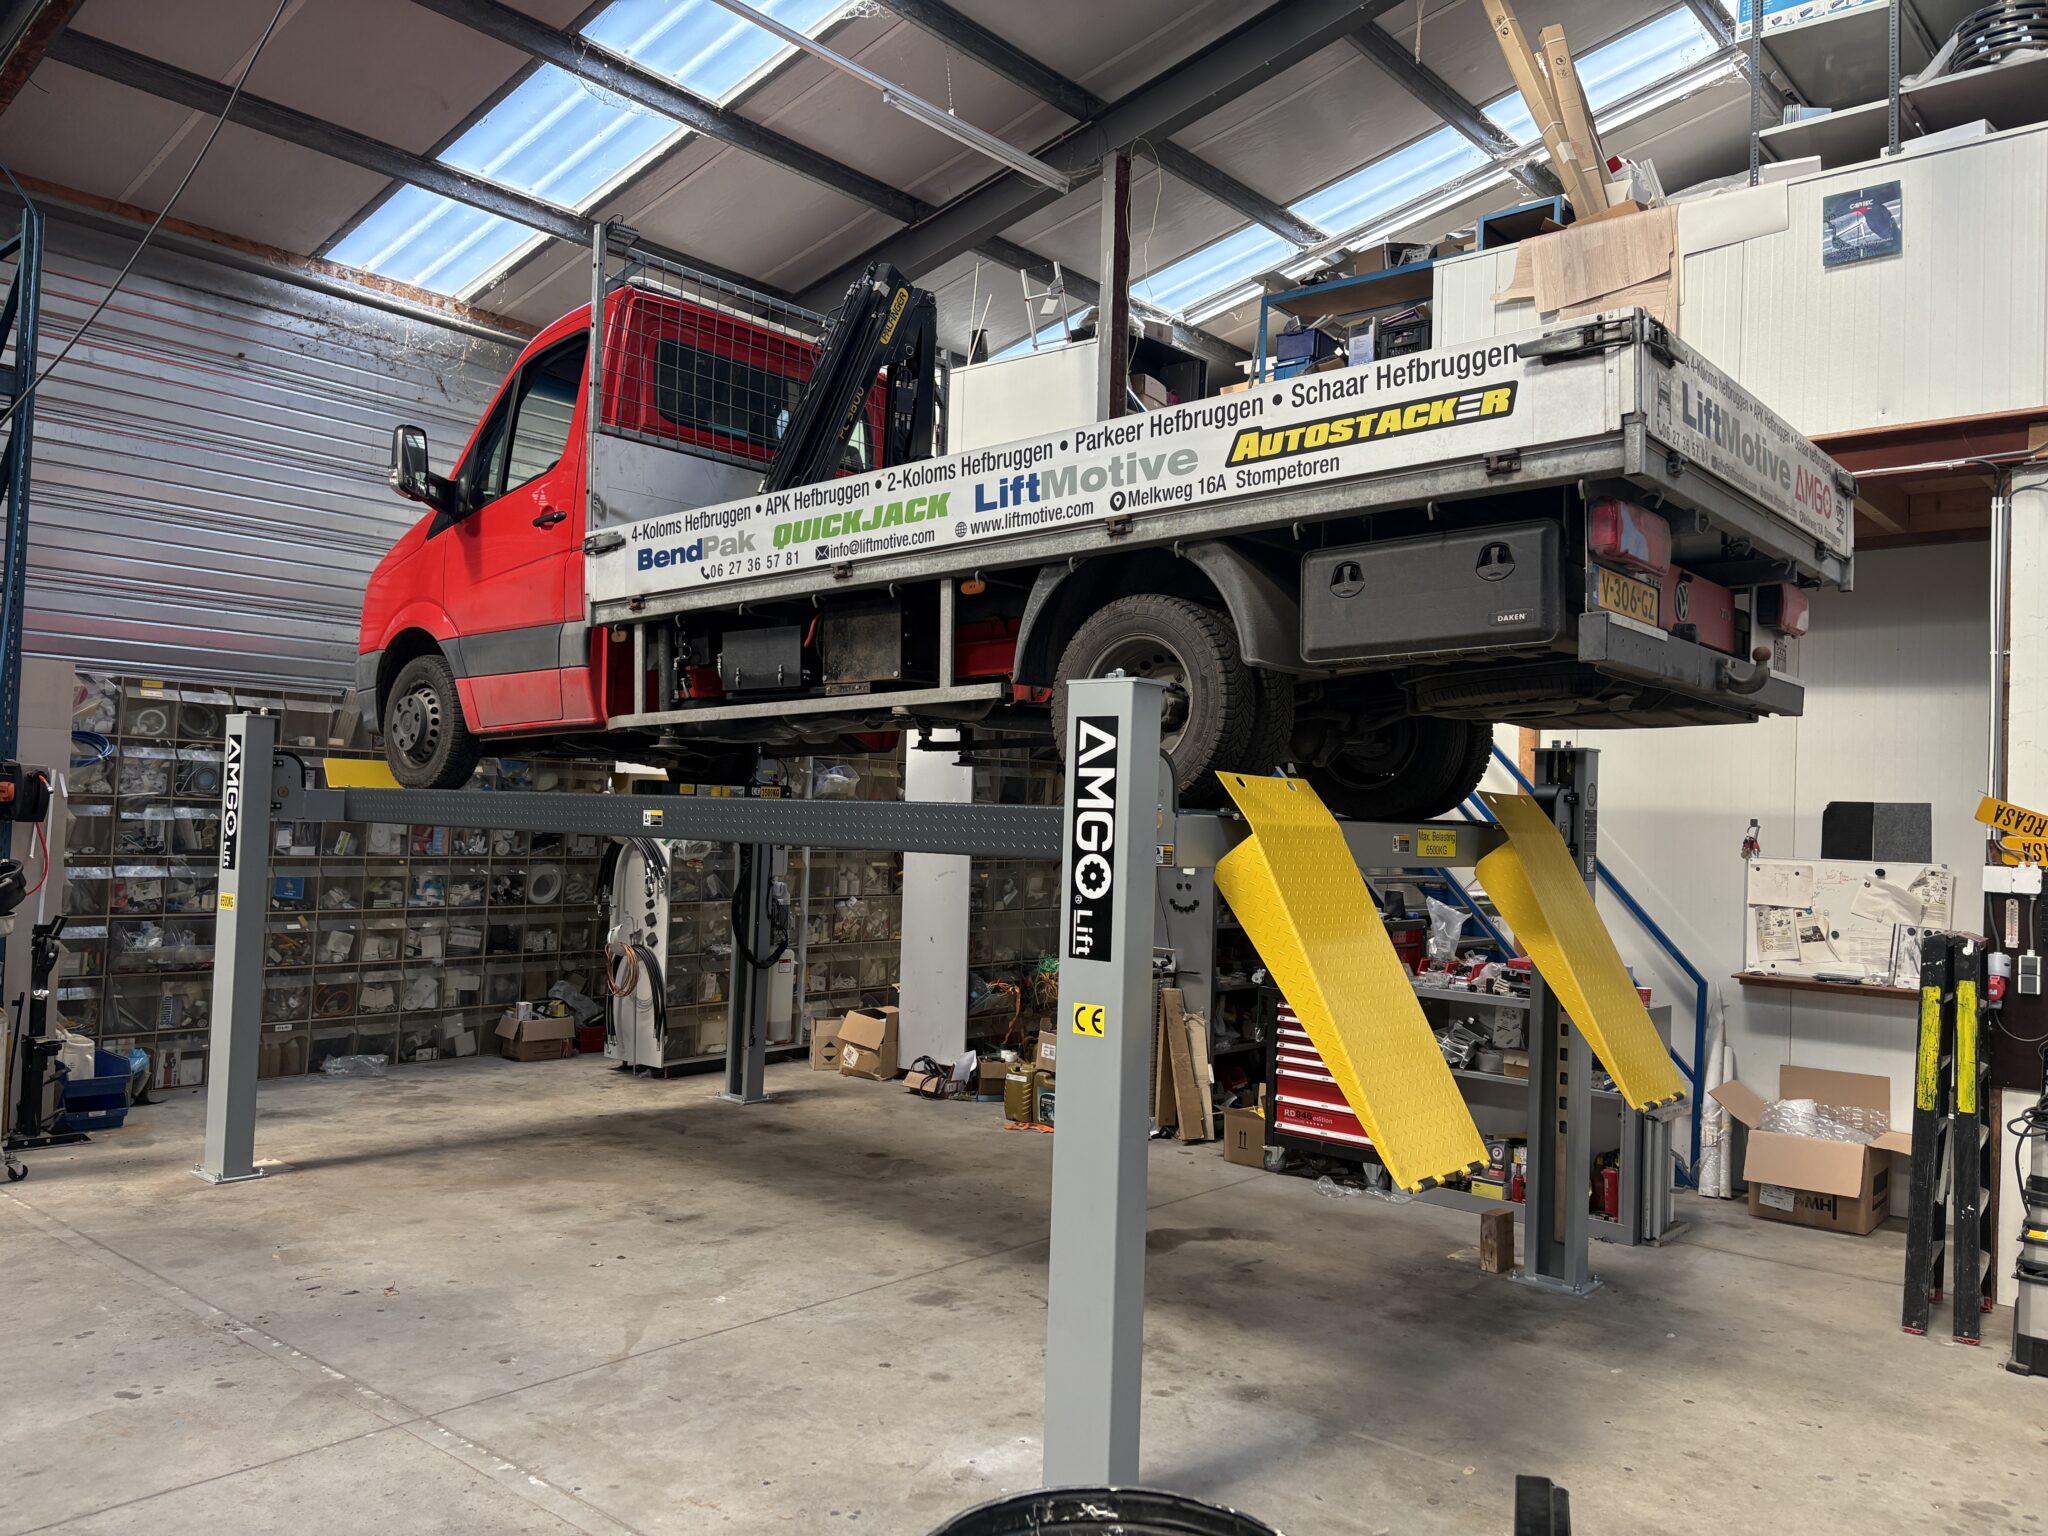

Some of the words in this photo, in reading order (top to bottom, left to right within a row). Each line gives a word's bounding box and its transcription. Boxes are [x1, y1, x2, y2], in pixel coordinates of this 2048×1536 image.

[883, 291, 908, 342] PALFINGER
[631, 520, 682, 543] 4-Koloms
[685, 505, 751, 533] Hefbruggen
[765, 494, 791, 516] APK
[794, 481, 869, 510] Hefbruggen
[887, 462, 956, 491] 2-Koloms
[961, 442, 1053, 477] Hefbruggen
[1075, 422, 1144, 453] Parkeer
[1150, 397, 1263, 438] Hefbruggen
[1292, 374, 1368, 408] Schaar
[1376, 343, 1518, 390] Hefbruggen
[1682, 381, 1791, 490] LiftMotive
[975, 448, 1199, 513] LiftMotive
[1128, 482, 1193, 508] Melkweg
[1198, 473, 1227, 495] 16A
[1236, 456, 1340, 489] Stompetoren
[1795, 464, 1832, 519] AMGO
[773, 492, 951, 550] QUICKJACK
[970, 501, 1094, 535] www.liftmotive.com
[638, 530, 756, 571] BendPak
[710, 564, 724, 578] 06
[729, 561, 742, 575] 27
[747, 557, 761, 572] 36
[766, 554, 780, 569] 57
[786, 551, 799, 566] 81
[830, 529, 935, 559] info@liftmotive.com
[1497, 613, 1525, 622] DAKEN
[225, 736, 241, 836] AMGO
[1075, 720, 1117, 899] AMGO
[1074, 909, 1093, 956] Lift
[1074, 1006, 1103, 1035] CE
